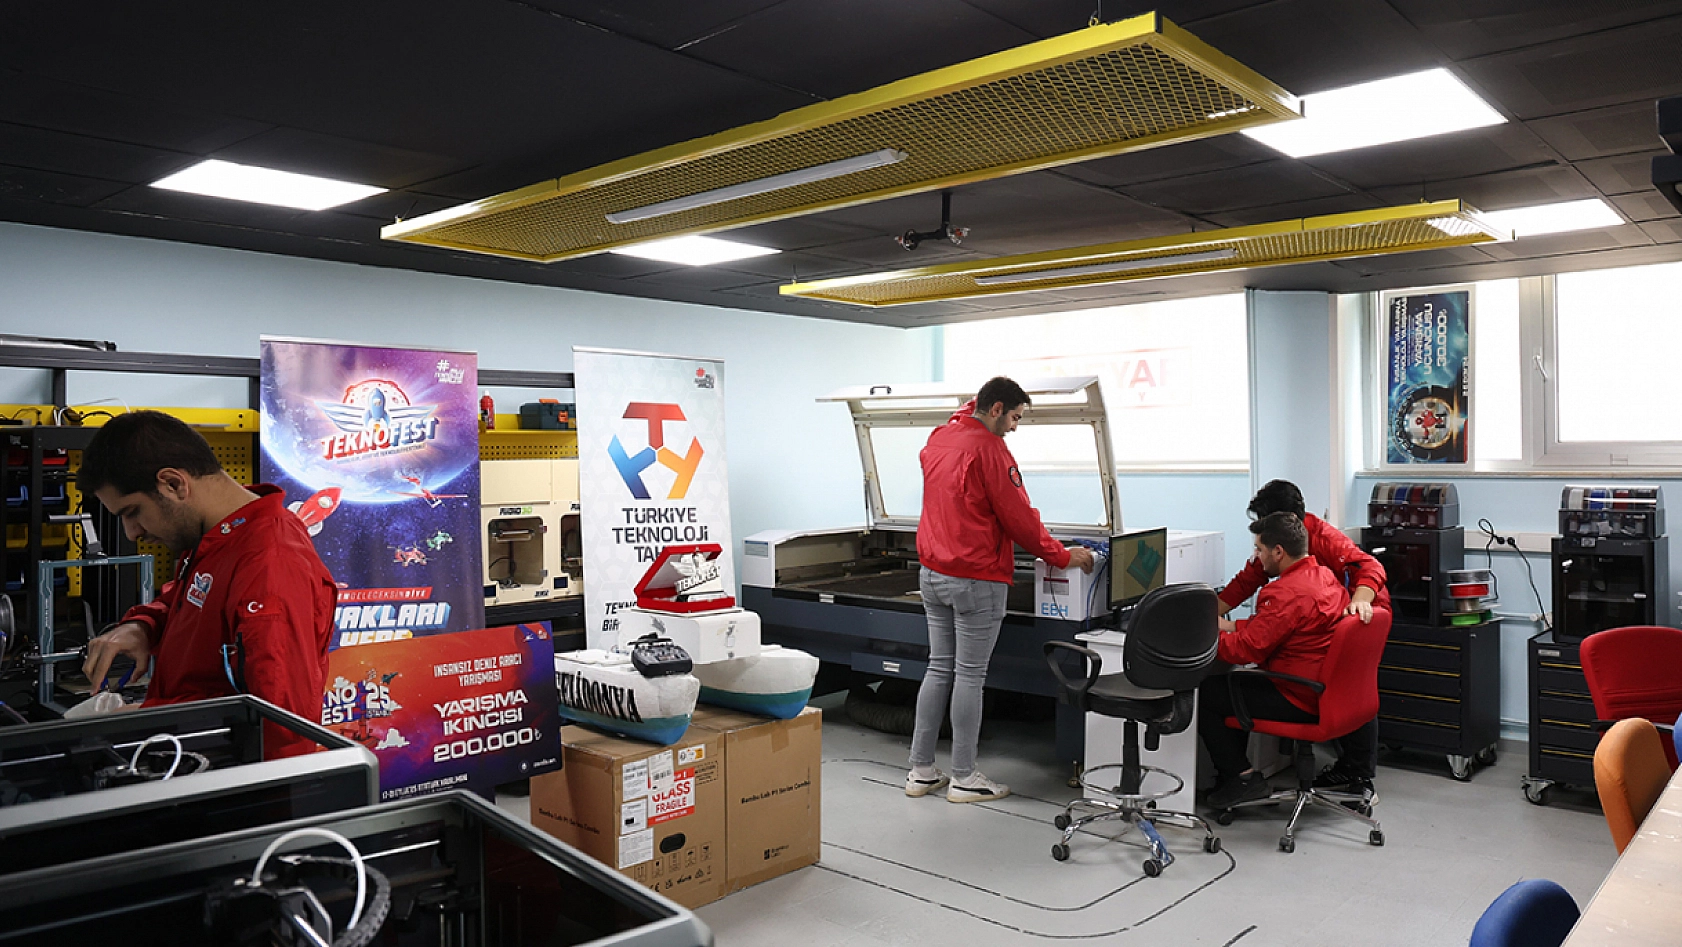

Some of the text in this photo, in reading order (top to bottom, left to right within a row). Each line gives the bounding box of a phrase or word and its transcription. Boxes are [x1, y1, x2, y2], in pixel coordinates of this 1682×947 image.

[321, 416, 440, 460] TEKNOFEST
[1041, 602, 1069, 617] EBH
[434, 689, 528, 718] YARIŞMA
[656, 797, 687, 813] FRAGILE
